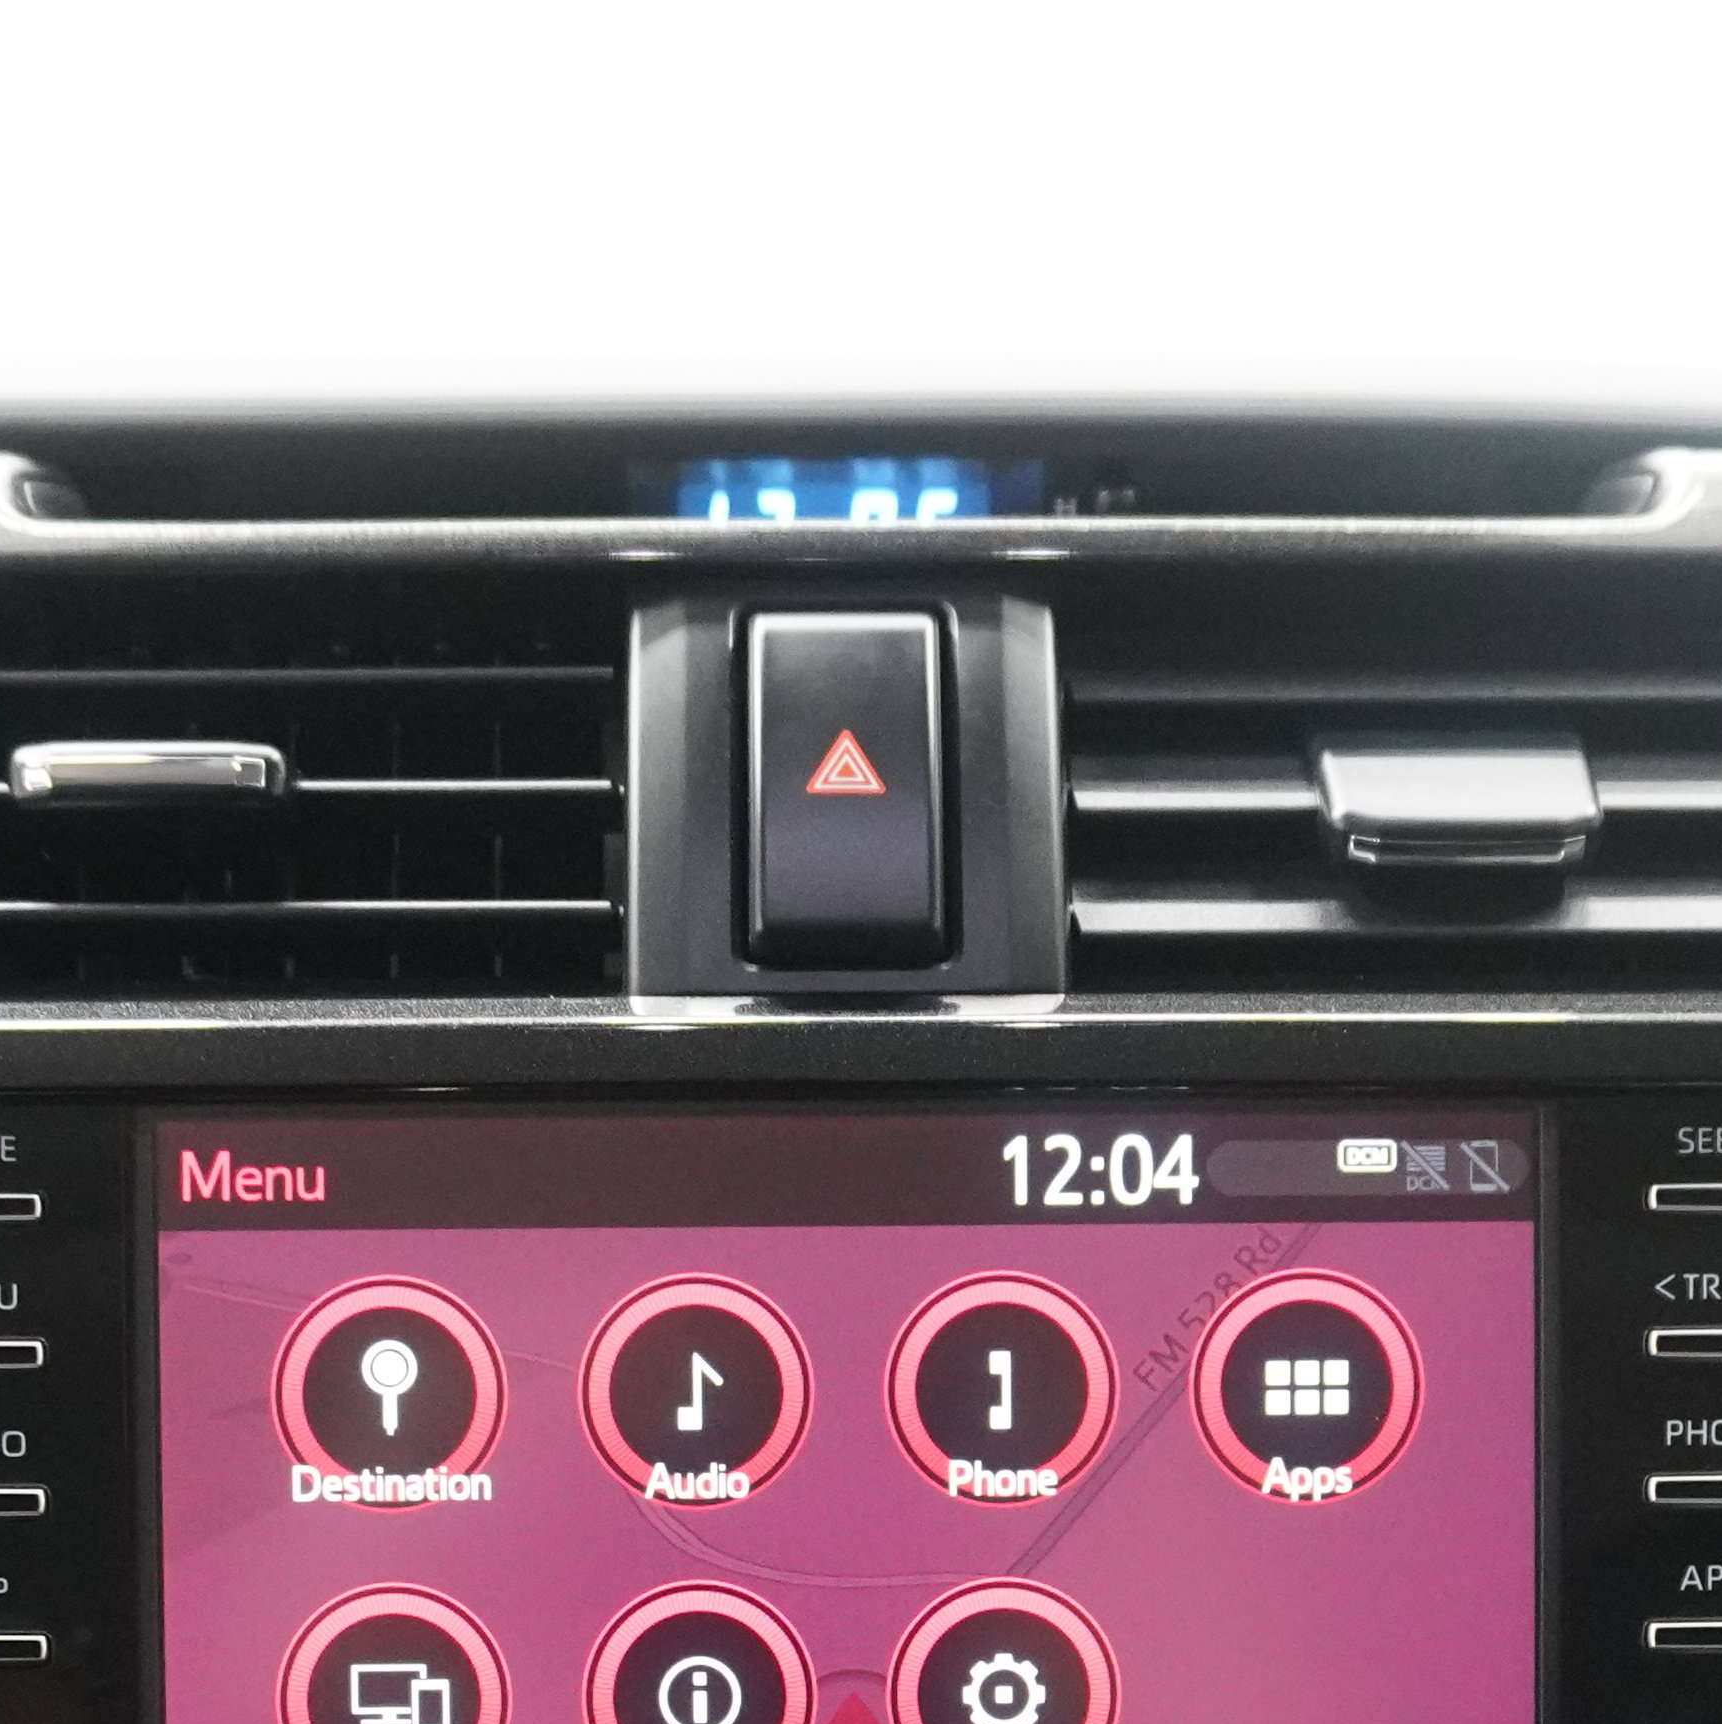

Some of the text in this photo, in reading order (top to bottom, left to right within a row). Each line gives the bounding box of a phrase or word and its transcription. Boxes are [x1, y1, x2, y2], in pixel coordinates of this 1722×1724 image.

[180, 1150, 327, 1203] Menu
[1001, 1133, 1200, 1206] 12:04
[1133, 1333, 1189, 1391] FM
[1234, 1226, 1282, 1275] Rd
[291, 1464, 492, 1503] Destination
[644, 1462, 750, 1500] Audio
[947, 1458, 1058, 1498] Phone
[1261, 1457, 1353, 1502] Apps
